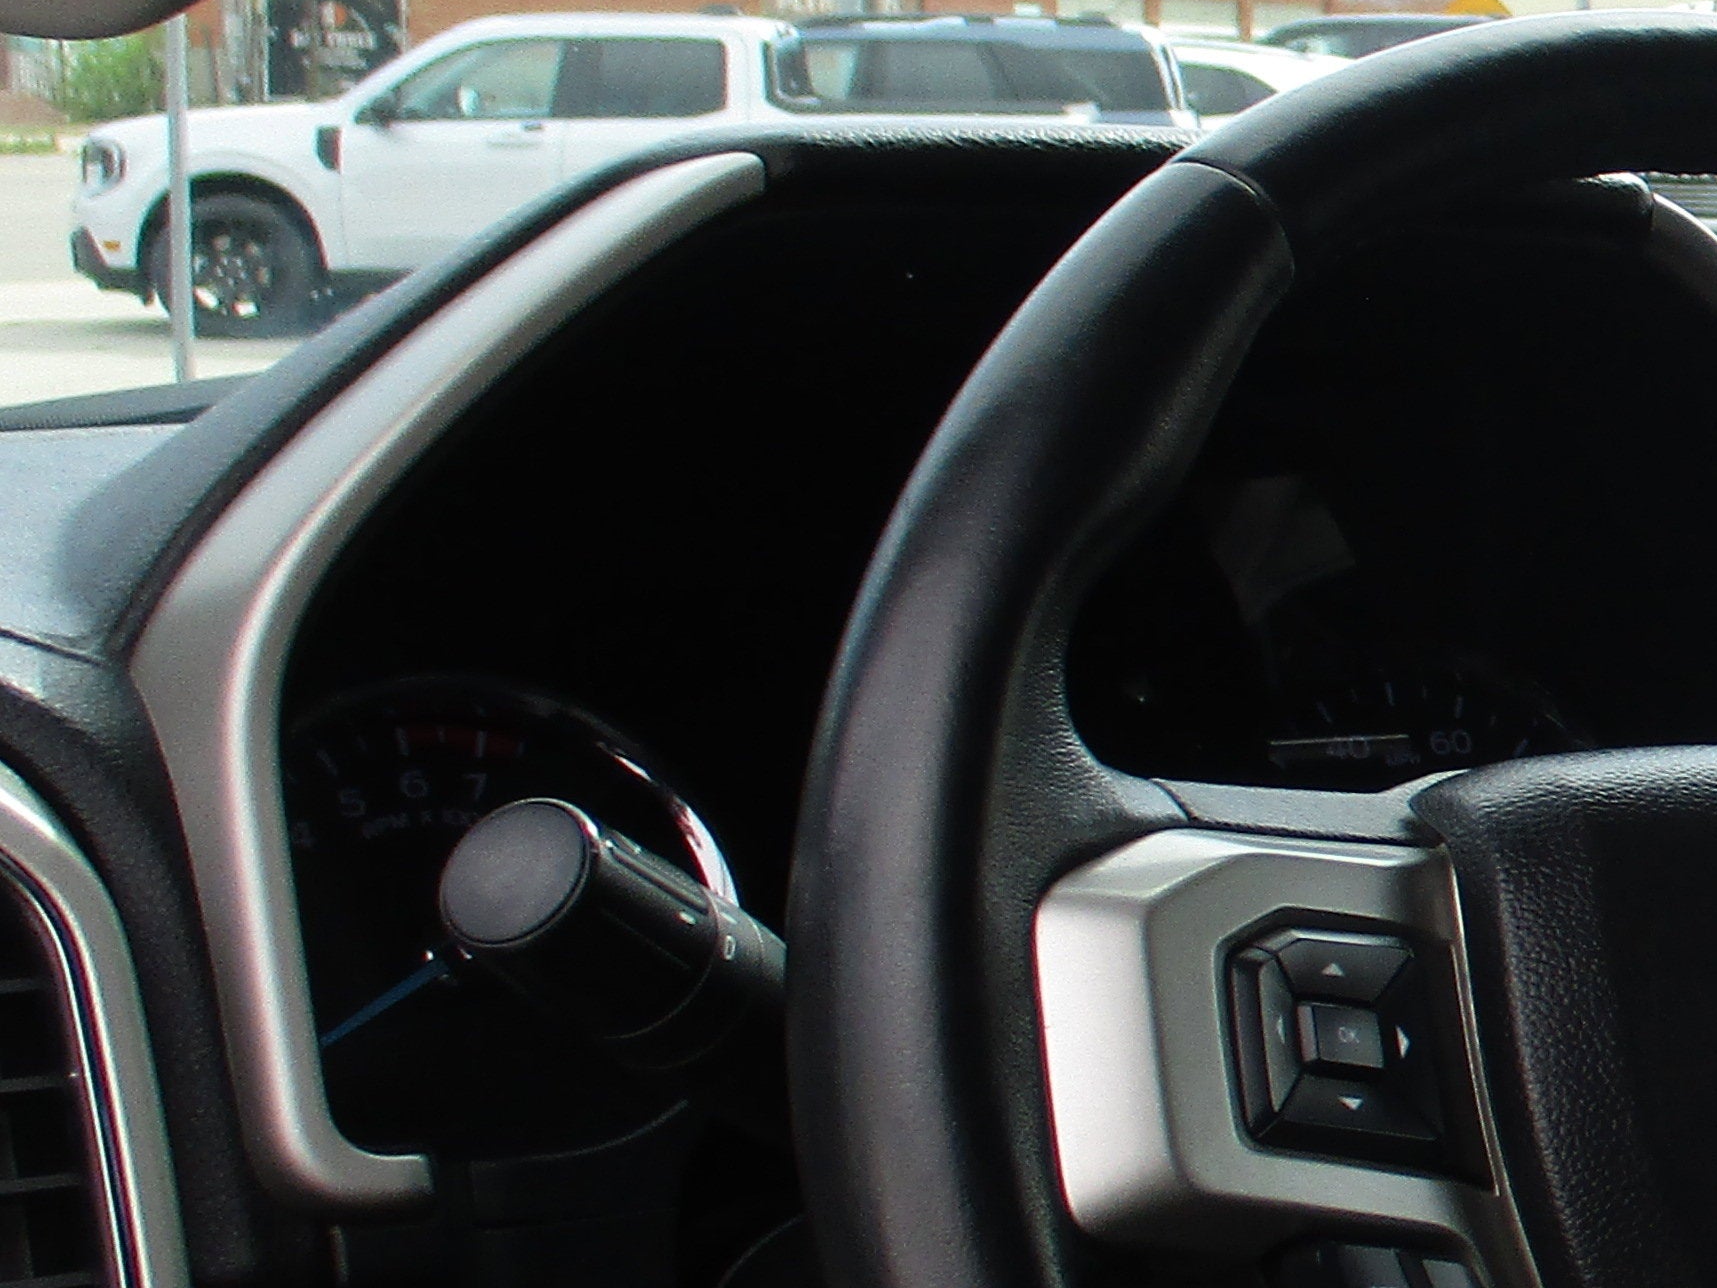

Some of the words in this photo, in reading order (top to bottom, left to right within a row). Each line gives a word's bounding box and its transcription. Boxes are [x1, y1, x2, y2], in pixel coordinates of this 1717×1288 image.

[1429, 728, 1473, 755] 60
[399, 768, 431, 799] 6
[462, 771, 489, 802] 7
[337, 786, 367, 819] 5
[1338, 1026, 1361, 1046] OK
